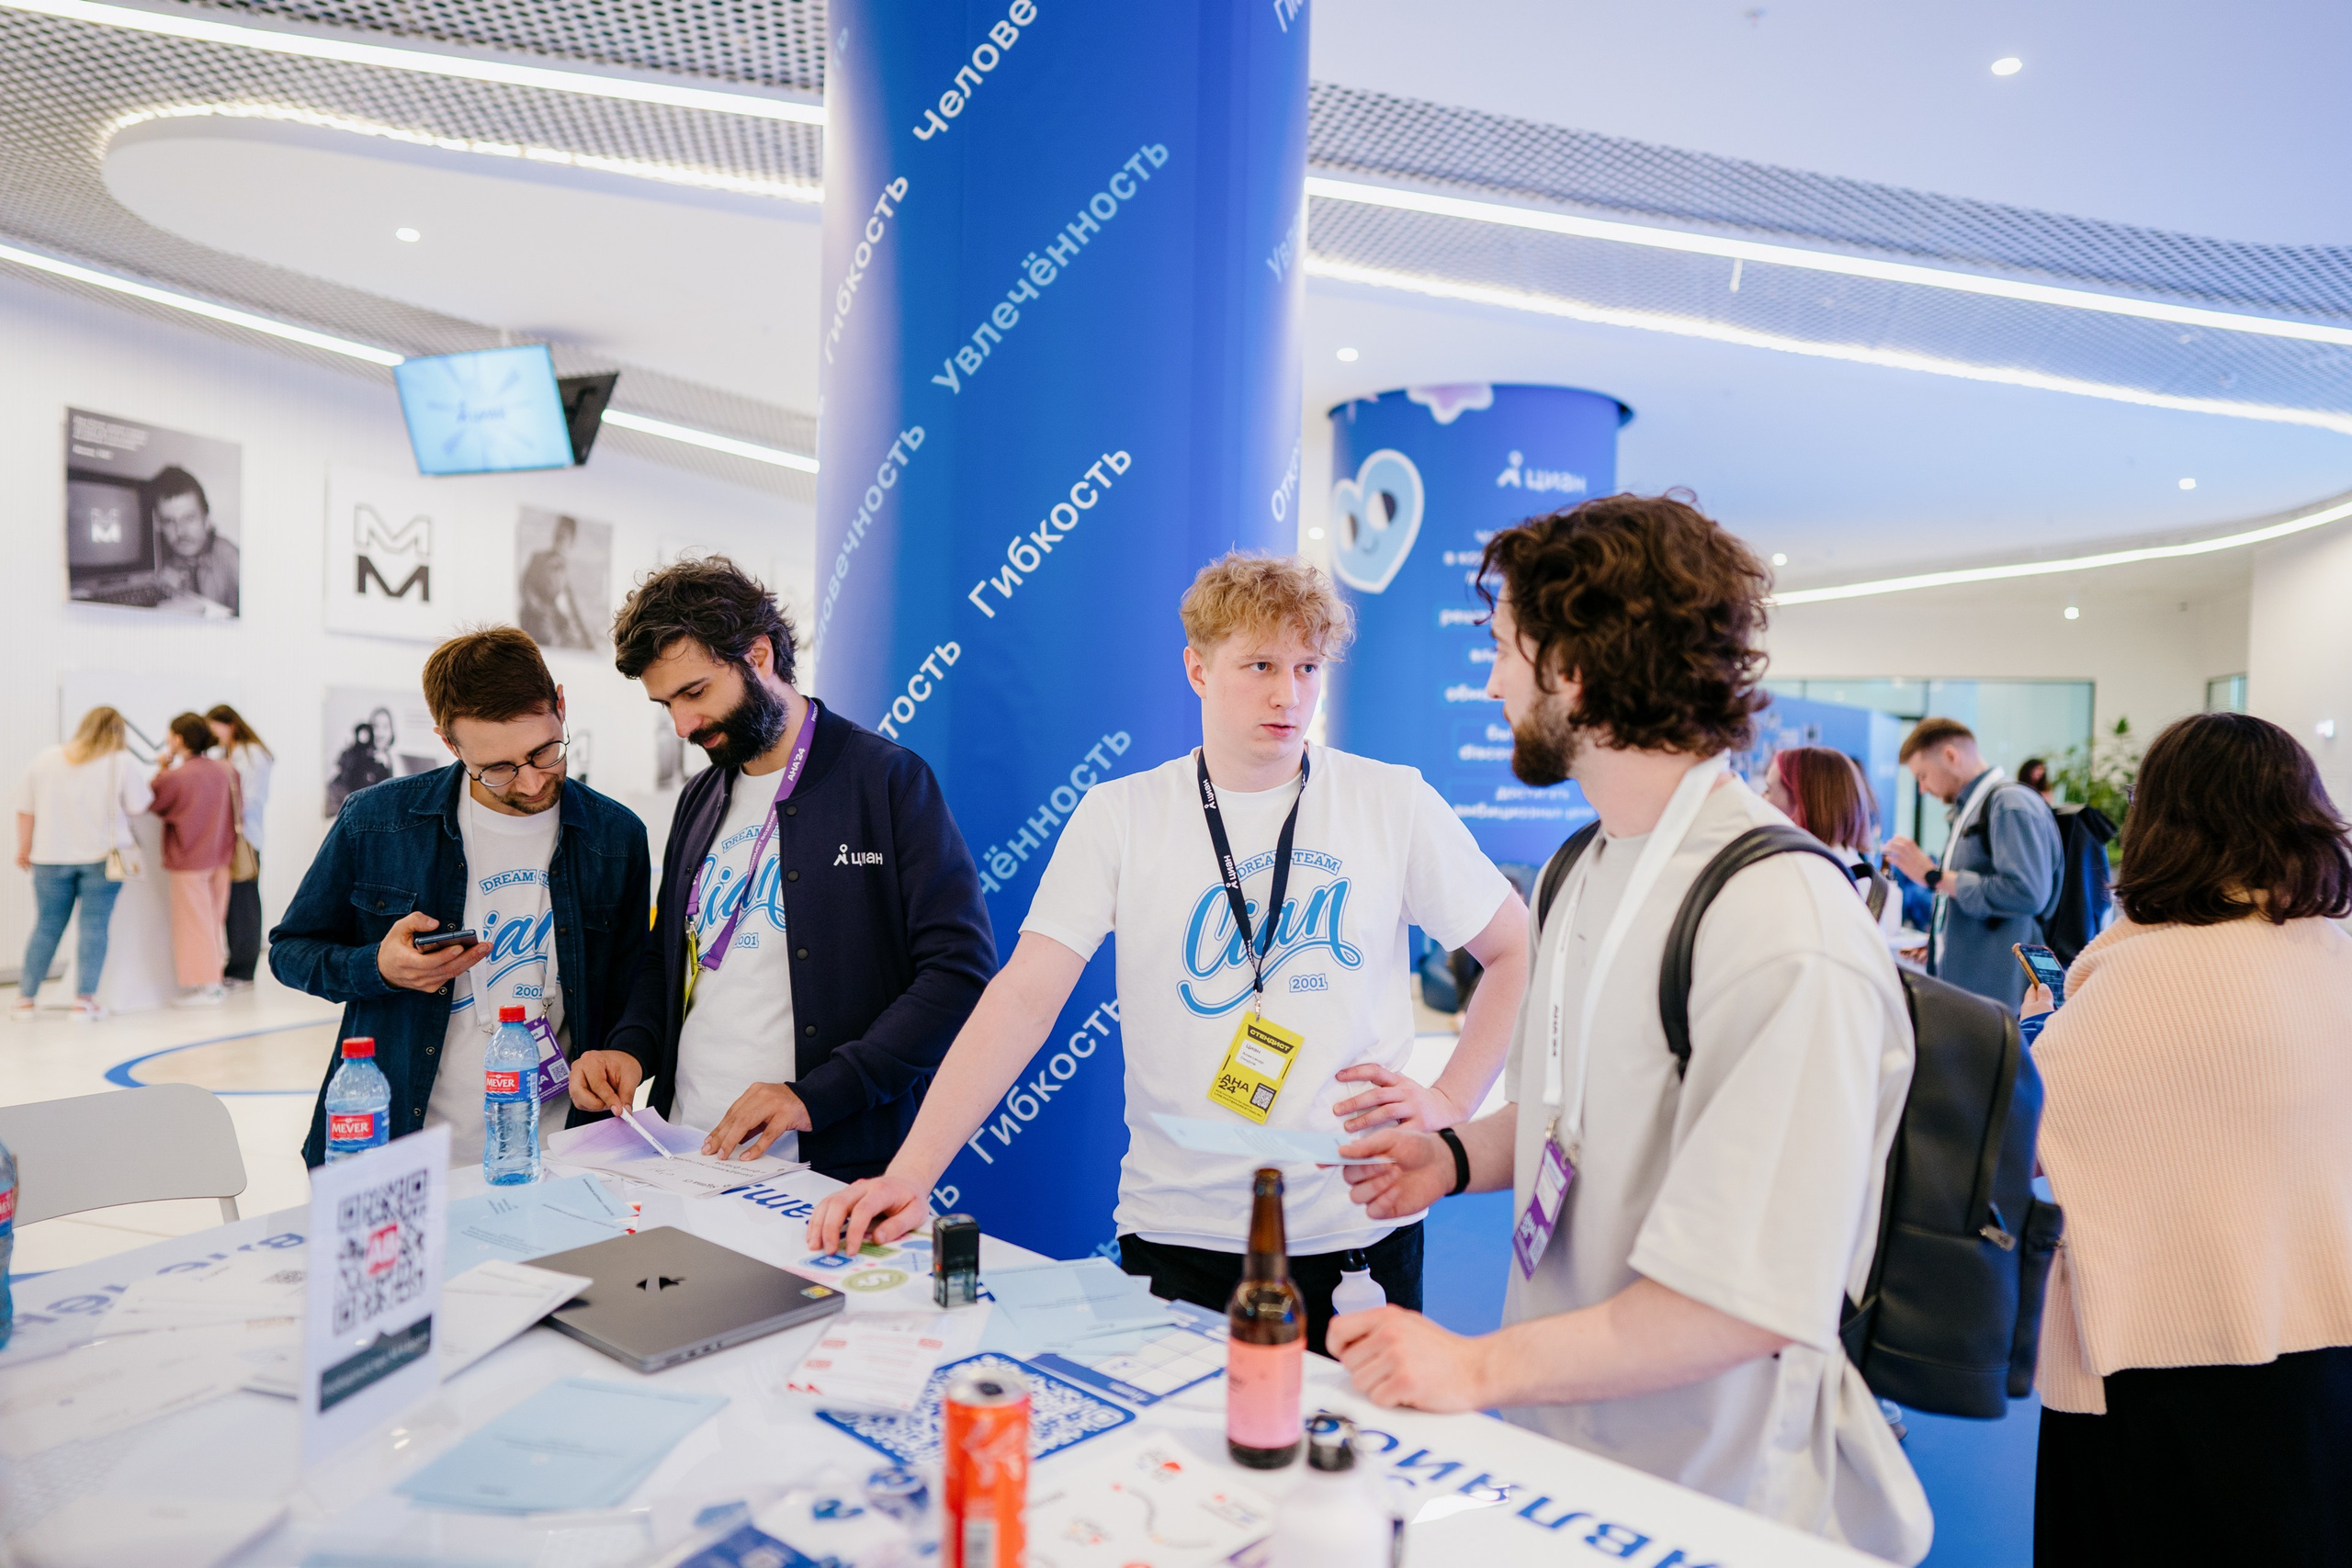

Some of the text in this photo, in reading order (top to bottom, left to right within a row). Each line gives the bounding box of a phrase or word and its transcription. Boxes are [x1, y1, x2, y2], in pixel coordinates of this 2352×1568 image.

[825, 175, 910, 364] Гибкость
[932, 142, 1170, 393] Увлечённость
[1525, 468, 1587, 494] циан
[967, 449, 1132, 618] Гибкость
[852, 851, 883, 866] циан
[1223, 854, 1238, 880] циан
[482, 871, 535, 894] DREAM
[1292, 977, 1326, 990] 2001
[1250, 1029, 1290, 1051] СТЕНДИСТ
[487, 1077, 515, 1088] MEVER
[967, 998, 1120, 1166] Гибкость
[332, 1122, 369, 1134] MEVER
